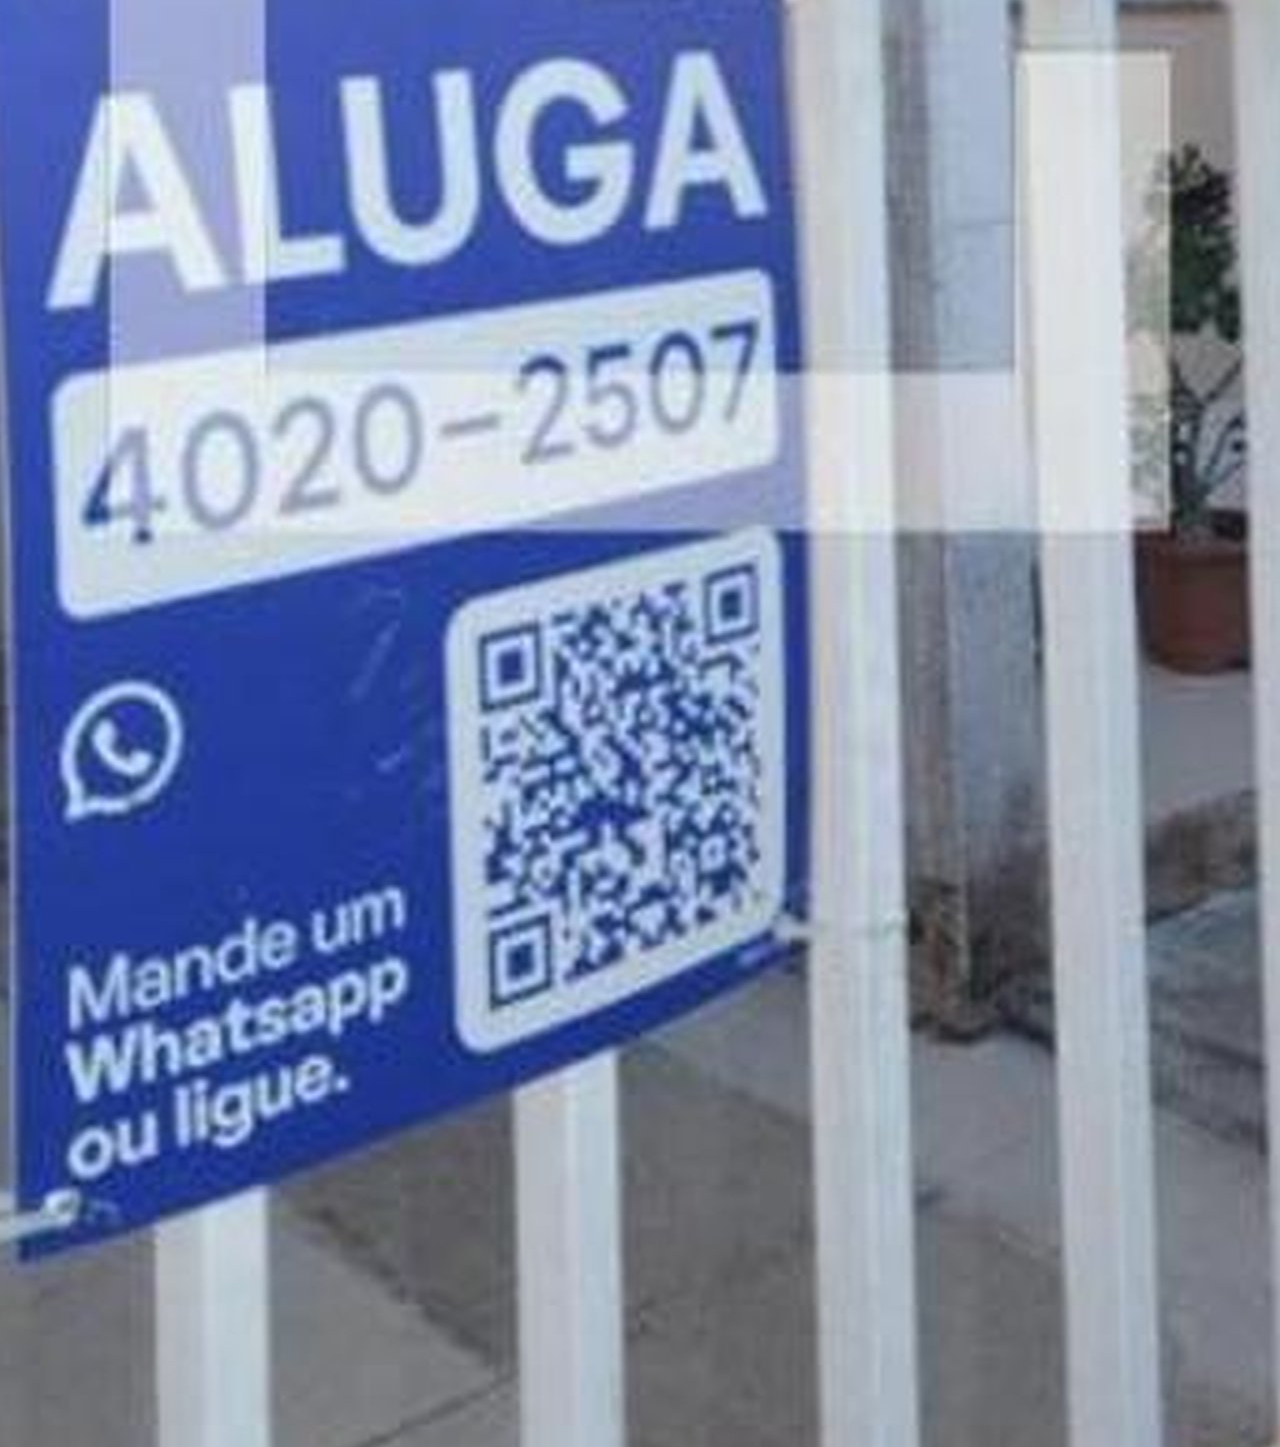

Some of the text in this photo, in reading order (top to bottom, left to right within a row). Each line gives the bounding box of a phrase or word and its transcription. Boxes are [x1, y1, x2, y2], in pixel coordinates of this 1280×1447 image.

[46, 50, 768, 311] ALUGA
[80, 321, 762, 545] 4020-2507
[65, 958, 408, 1102] Whatsapp
[68, 886, 405, 1031] Mande um
[68, 1055, 350, 1179] ou ligue.
